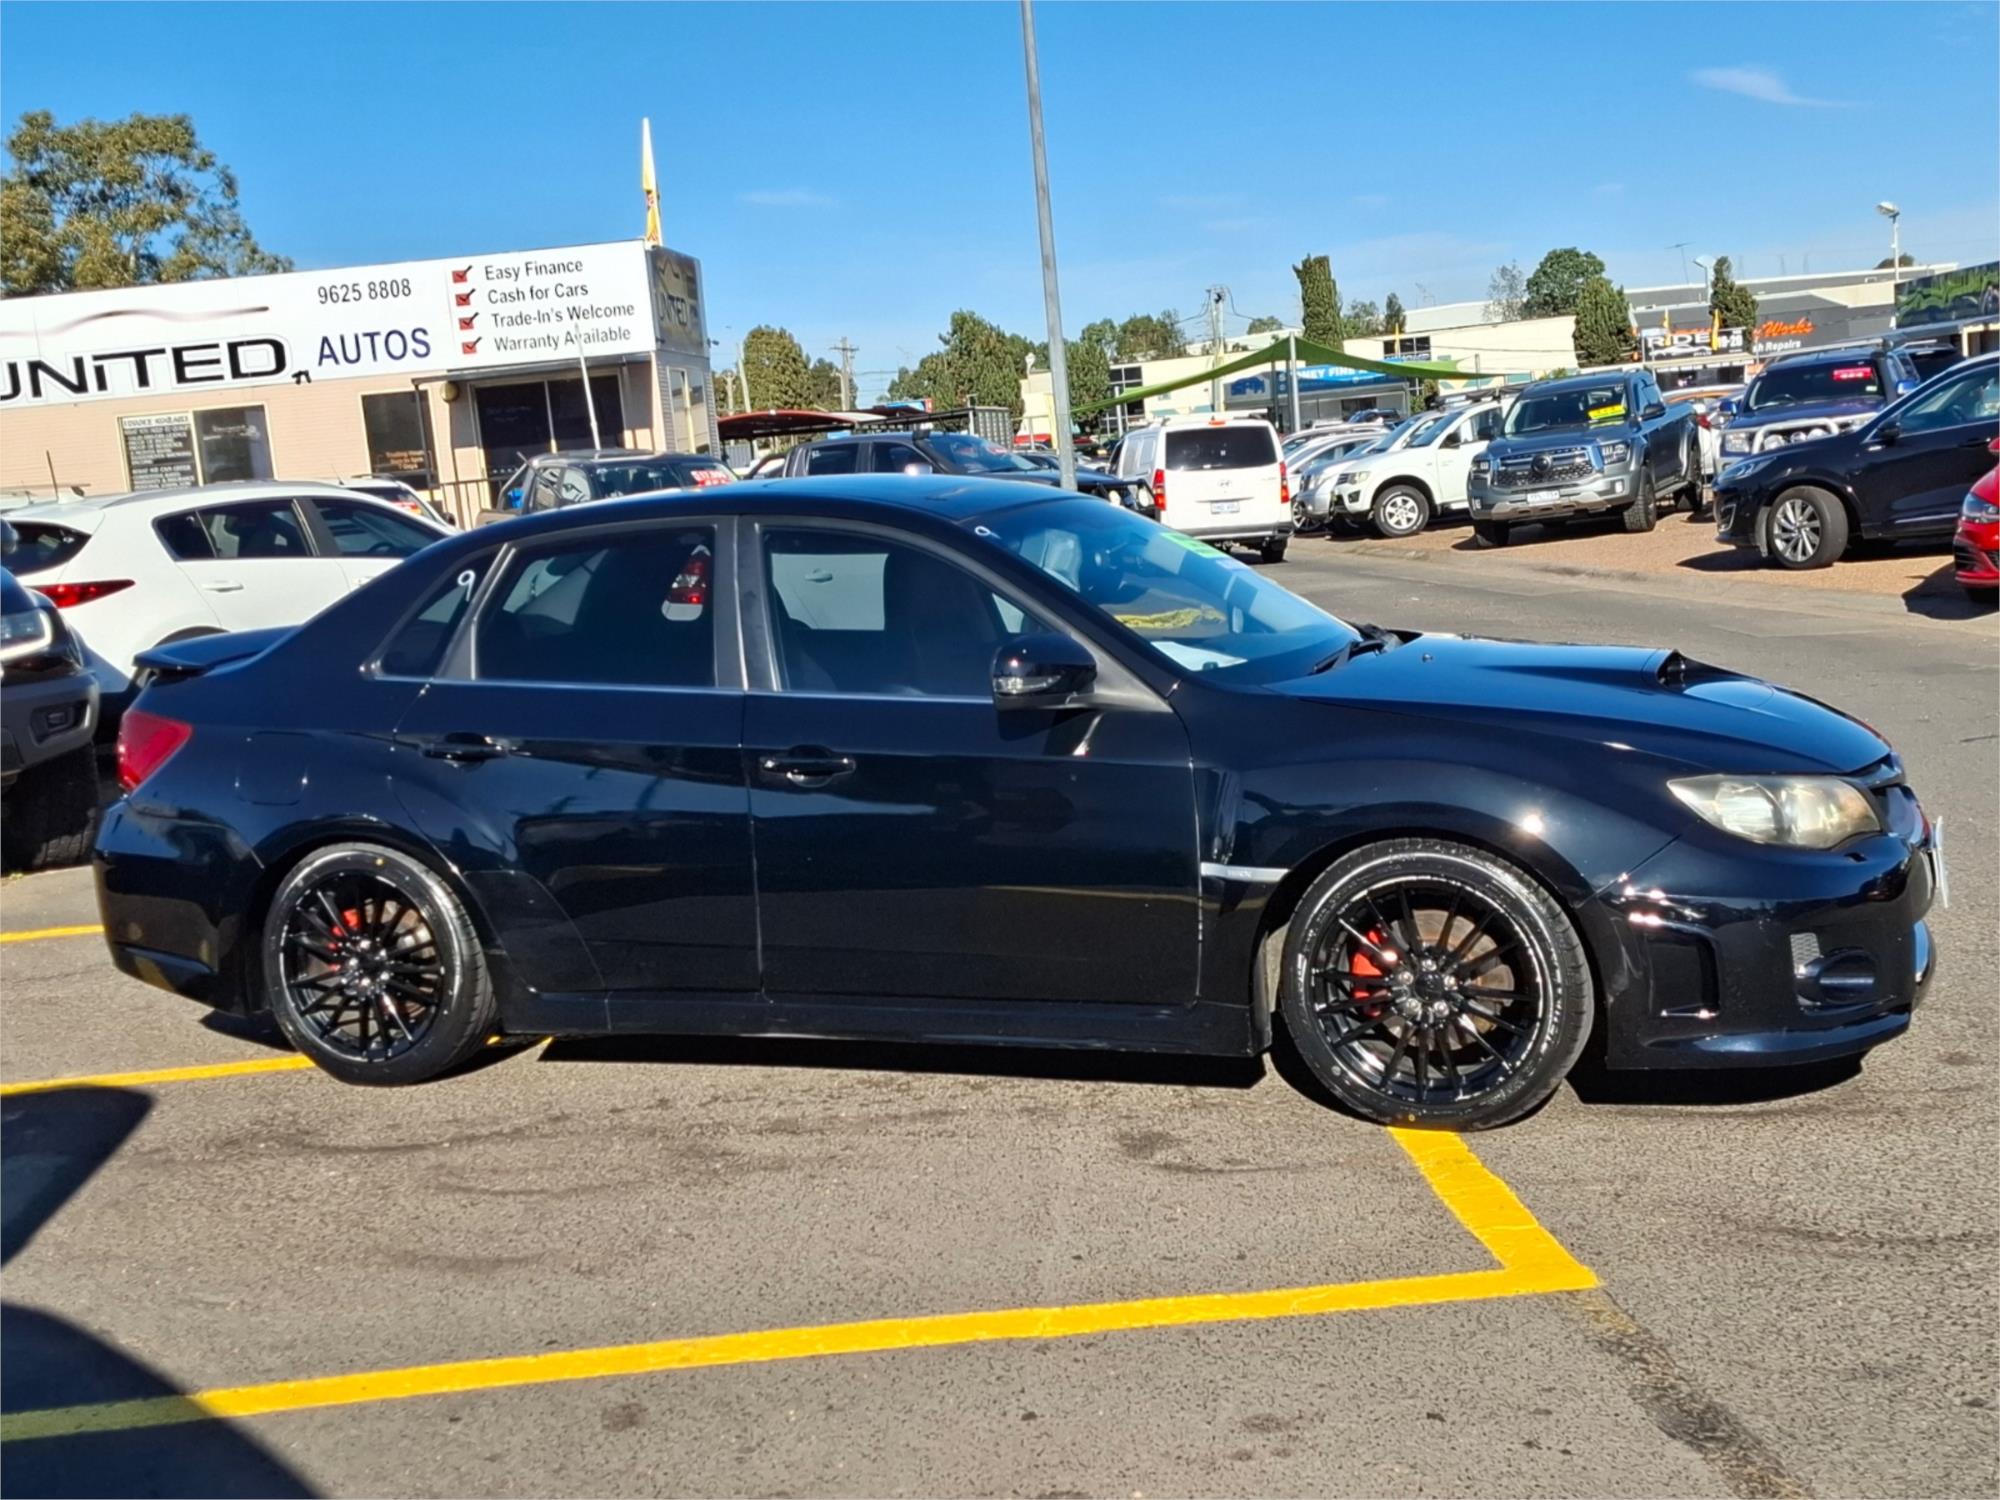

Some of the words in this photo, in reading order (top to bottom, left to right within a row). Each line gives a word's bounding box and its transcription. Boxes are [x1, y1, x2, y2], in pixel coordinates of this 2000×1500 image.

[485, 264, 520, 282] Easy
[525, 260, 583, 277] Finance
[318, 282, 362, 304] 9625
[368, 278, 411, 300] 8808
[488, 287, 525, 304] Cash
[530, 285, 549, 300] for
[554, 283, 589, 298] Cars
[491, 307, 563, 328] Trade-In's
[567, 304, 635, 321] Welcome
[318, 327, 431, 367] AUTOS
[494, 334, 560, 351] Warranty
[564, 325, 631, 345] Available
[1647, 333, 1711, 348] RDE
[1765, 339, 1801, 353] Repairs
[457, 569, 476, 602] 9
